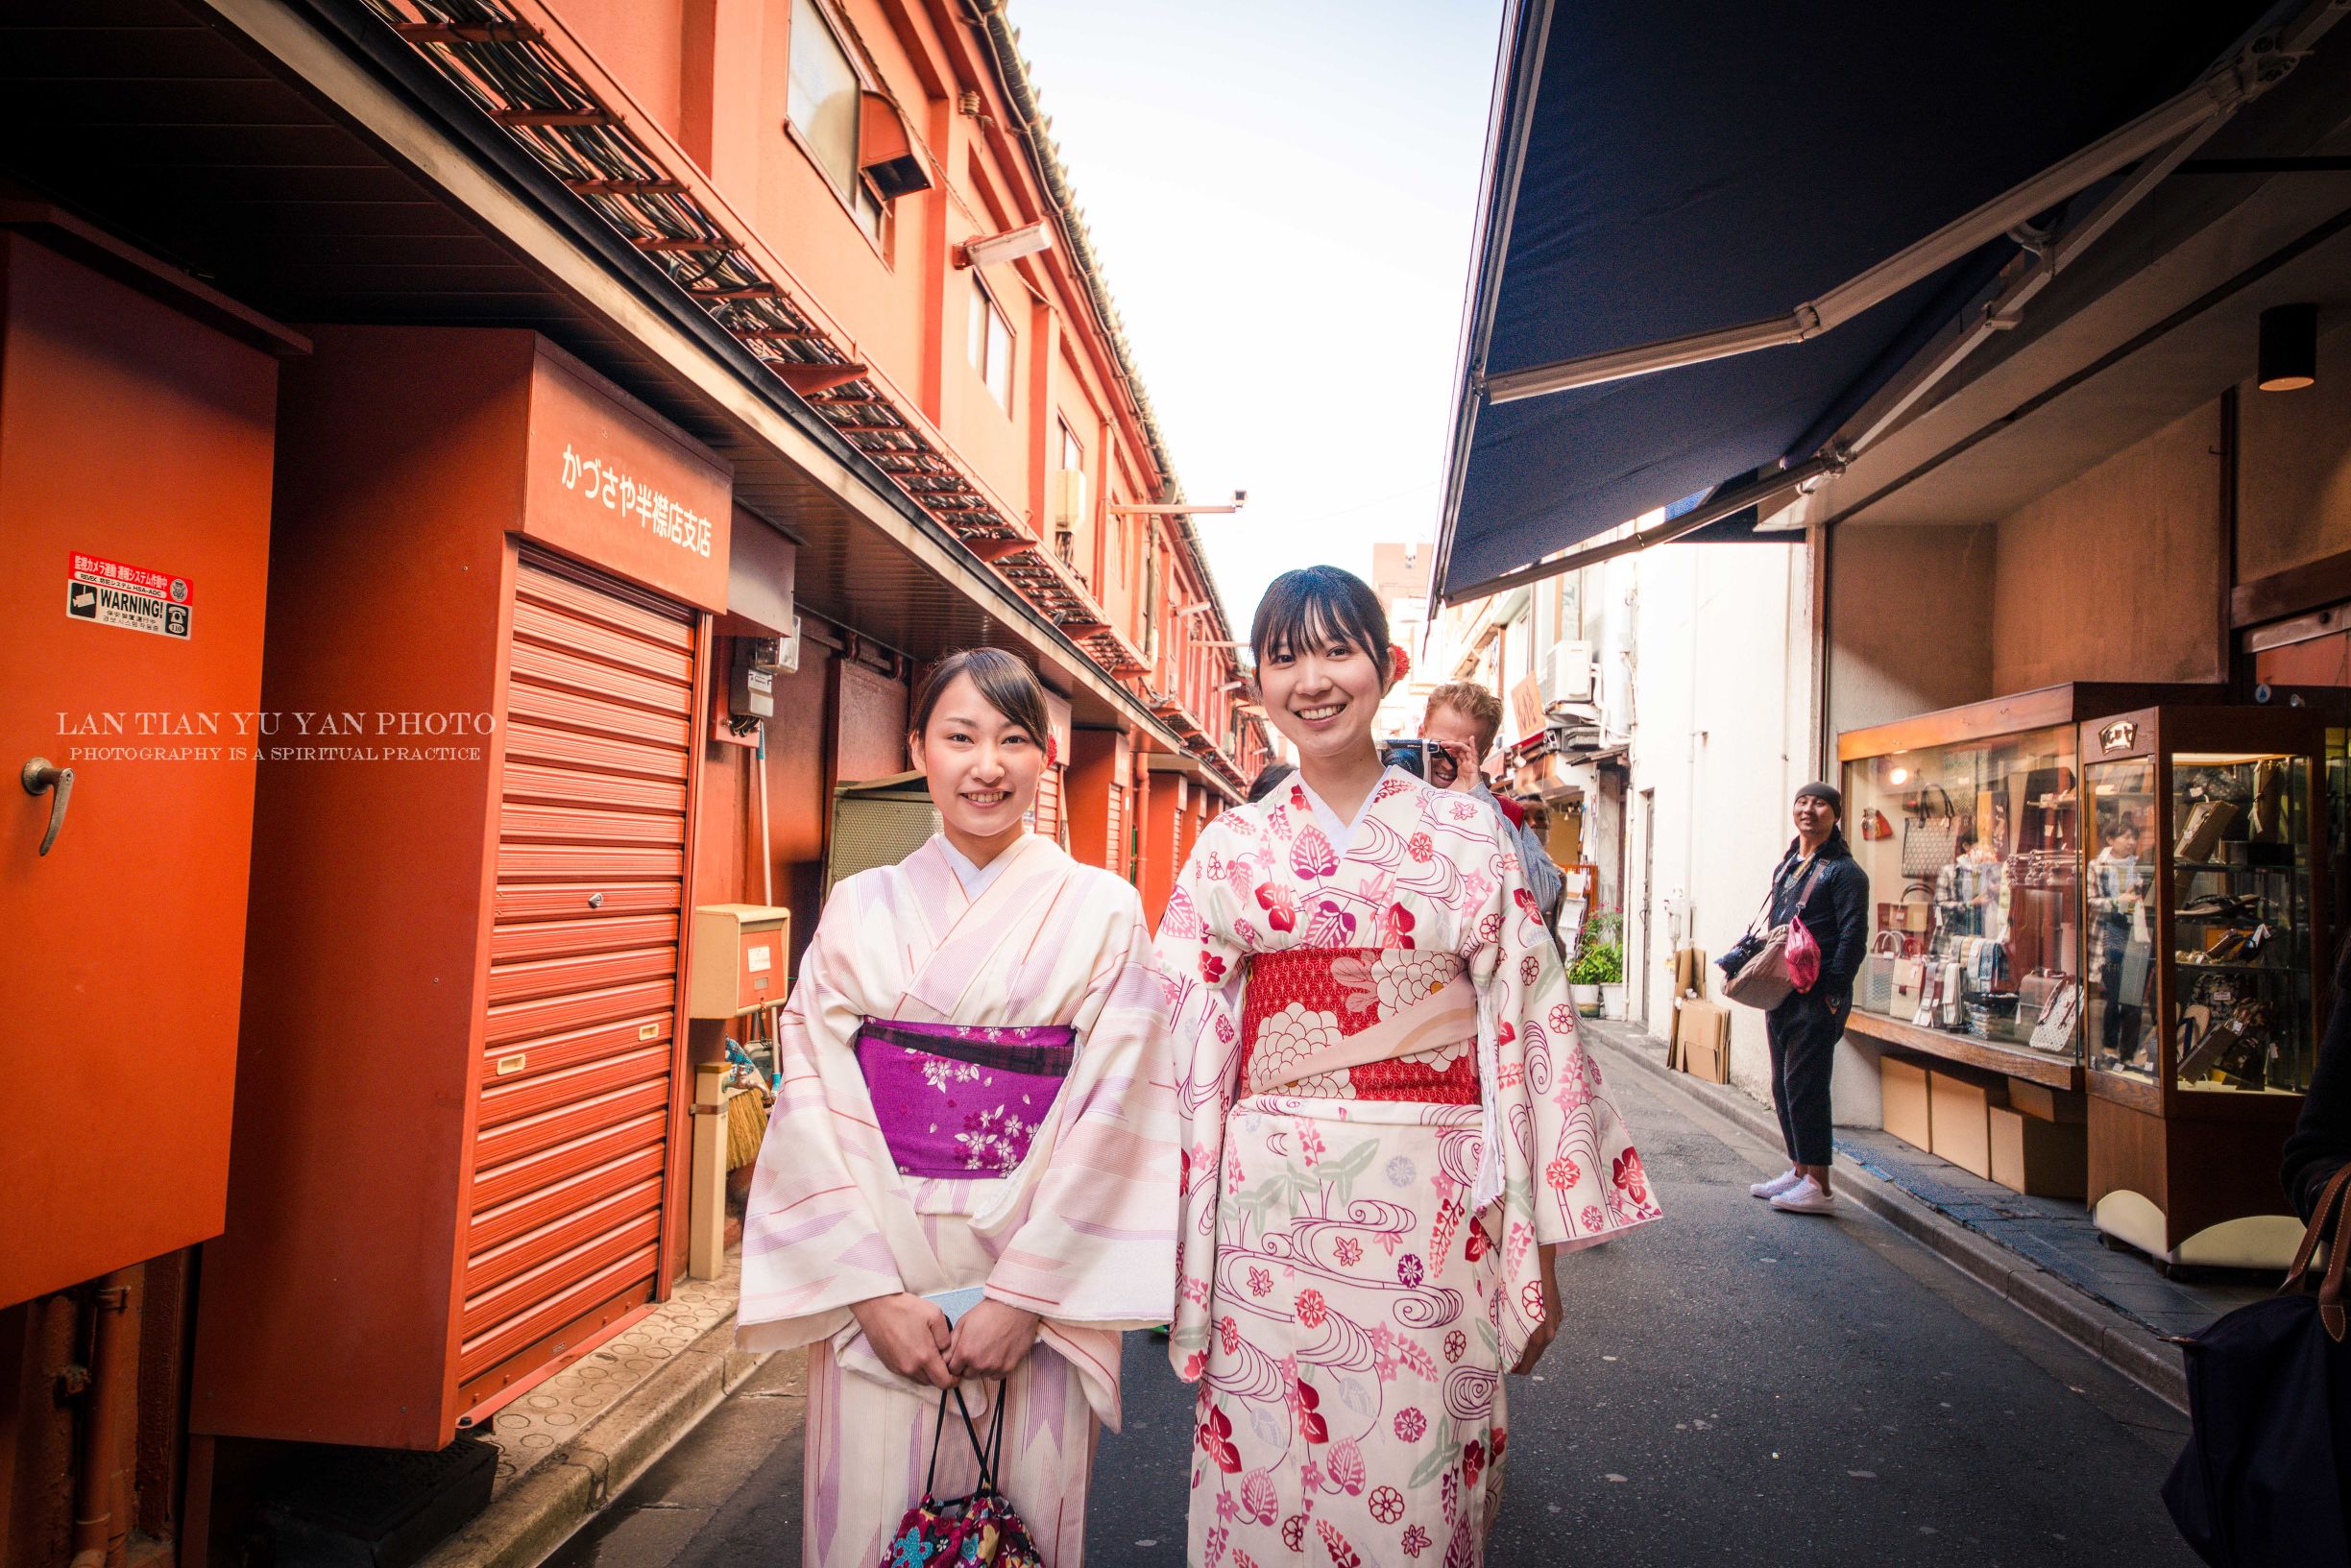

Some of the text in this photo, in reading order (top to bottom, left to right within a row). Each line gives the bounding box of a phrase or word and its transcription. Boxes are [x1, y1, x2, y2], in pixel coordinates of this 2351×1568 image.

[562, 444, 712, 558] かづさや半襟店支店
[101, 589, 163, 619] WARNING!
[171, 624, 182, 633] 110
